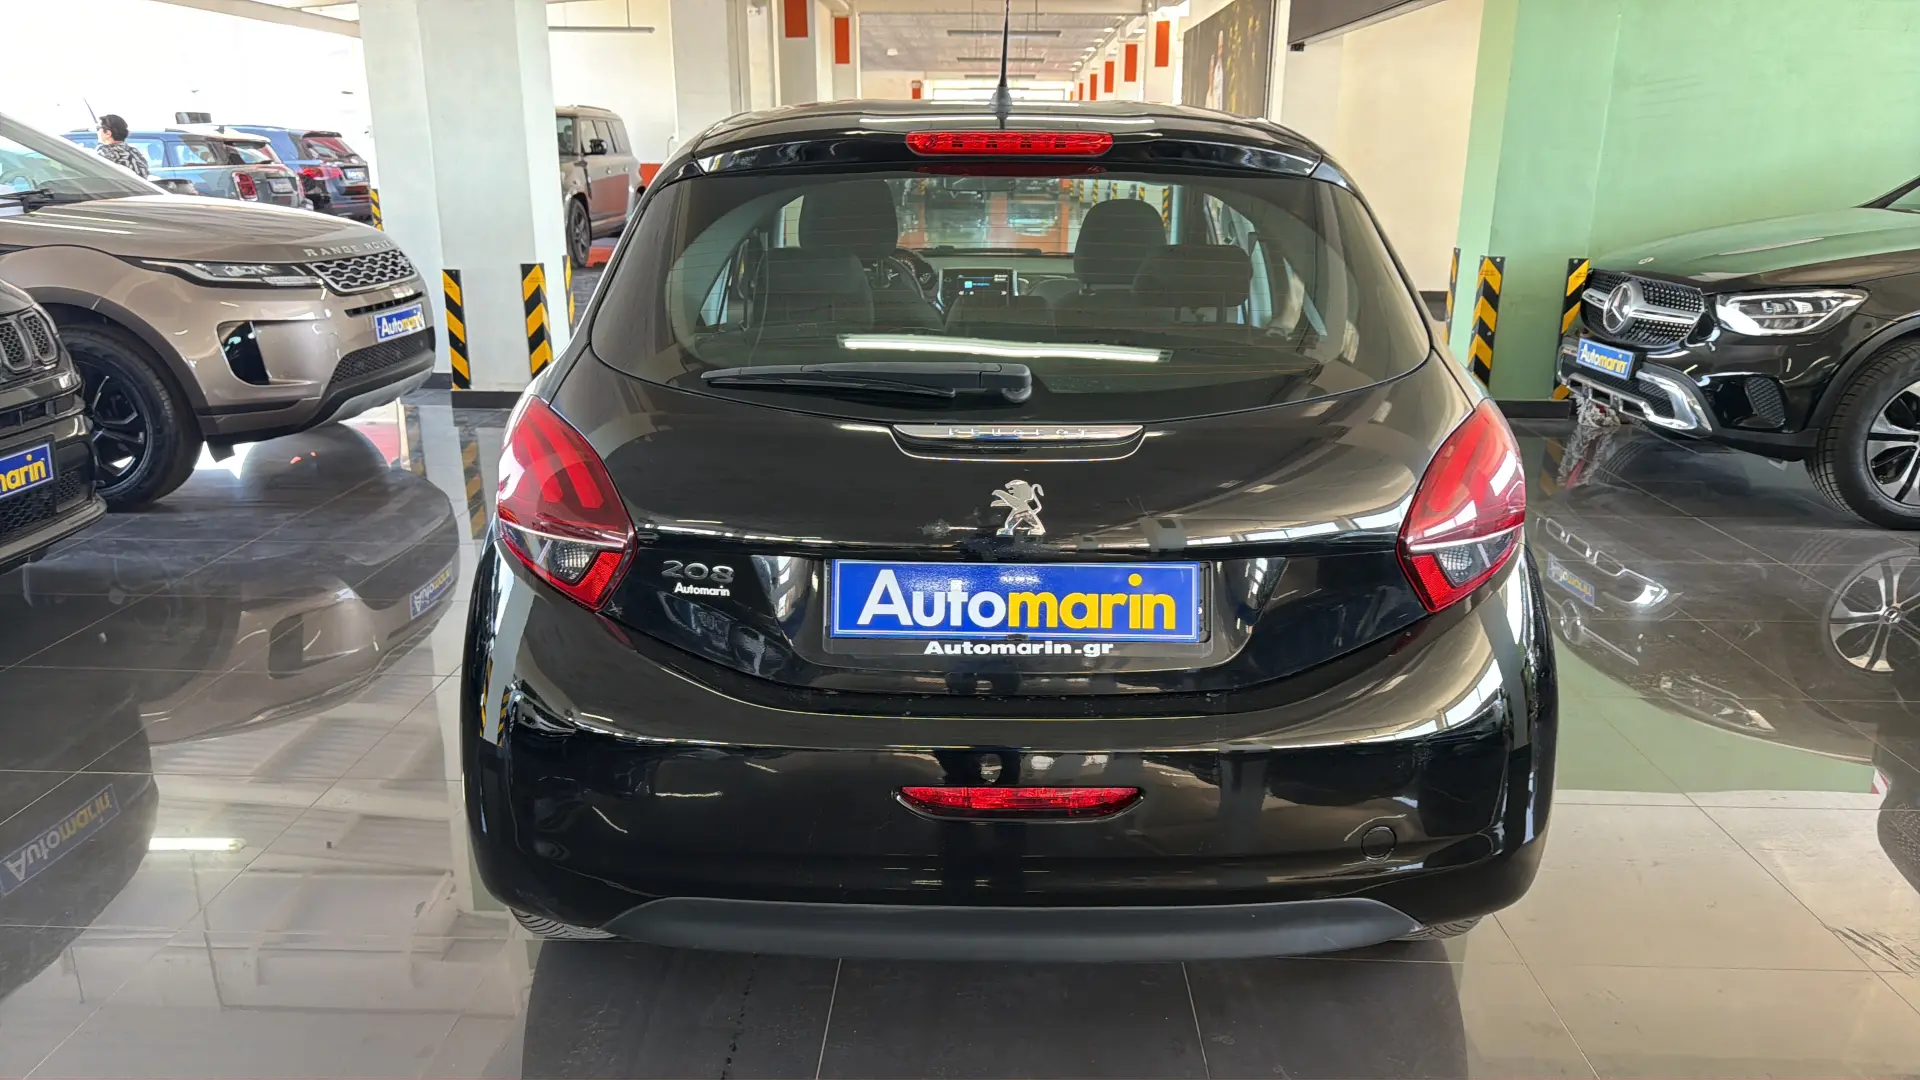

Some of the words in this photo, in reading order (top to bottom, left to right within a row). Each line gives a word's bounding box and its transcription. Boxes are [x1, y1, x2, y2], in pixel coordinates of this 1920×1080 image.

[303, 244, 361, 258] RANGE
[1580, 343, 1628, 374] Automarin
[661, 560, 735, 583] 208
[674, 582, 730, 597] Automarin
[856, 569, 1176, 630] Automarin
[923, 640, 1113, 657] Automarin.gr
